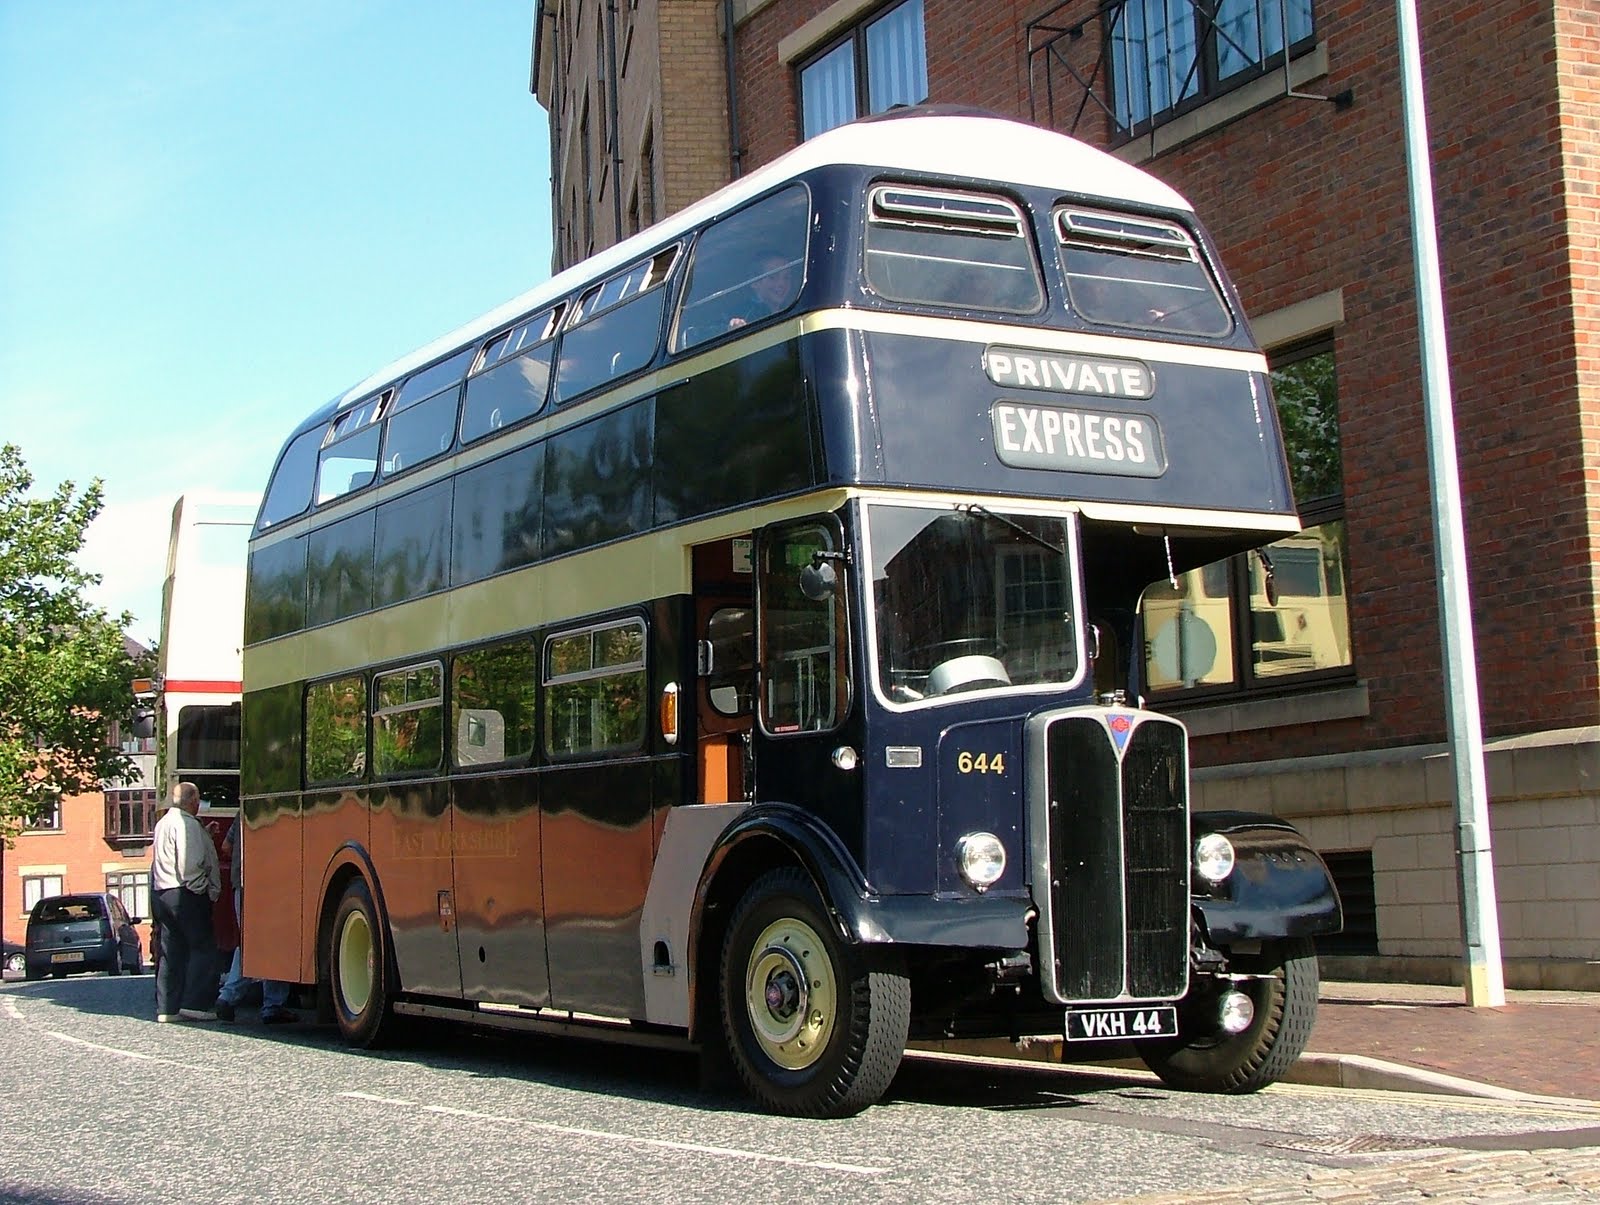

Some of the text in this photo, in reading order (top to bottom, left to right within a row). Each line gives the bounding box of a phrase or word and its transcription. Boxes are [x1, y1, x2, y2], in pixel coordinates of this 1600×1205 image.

[989, 354, 1145, 396] PRIVATE
[998, 406, 1146, 463] EXPRESS
[958, 751, 1004, 774] 644
[1081, 1010, 1161, 1037] VKH 44
